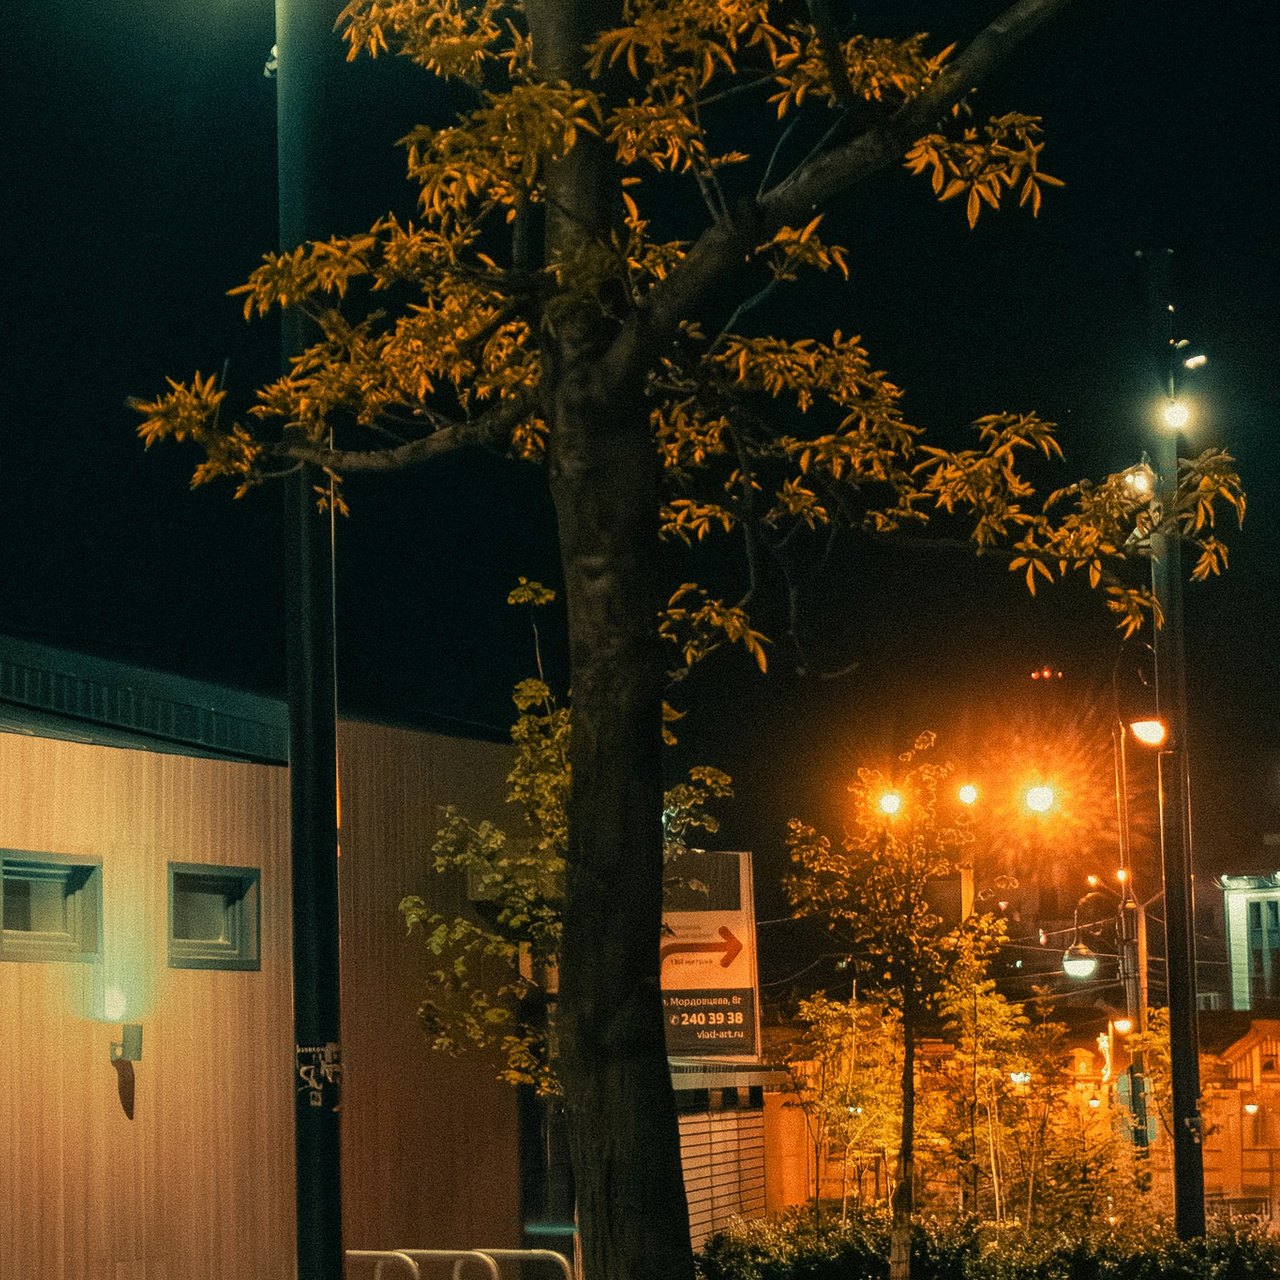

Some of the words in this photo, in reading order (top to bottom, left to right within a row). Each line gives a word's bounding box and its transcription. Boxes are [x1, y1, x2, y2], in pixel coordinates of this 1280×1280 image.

[681, 1012, 706, 1026] 240
[708, 1012, 725, 1025] 39
[726, 1011, 744, 1025] 38
[696, 1029, 744, 1039] vlad-art.ru
